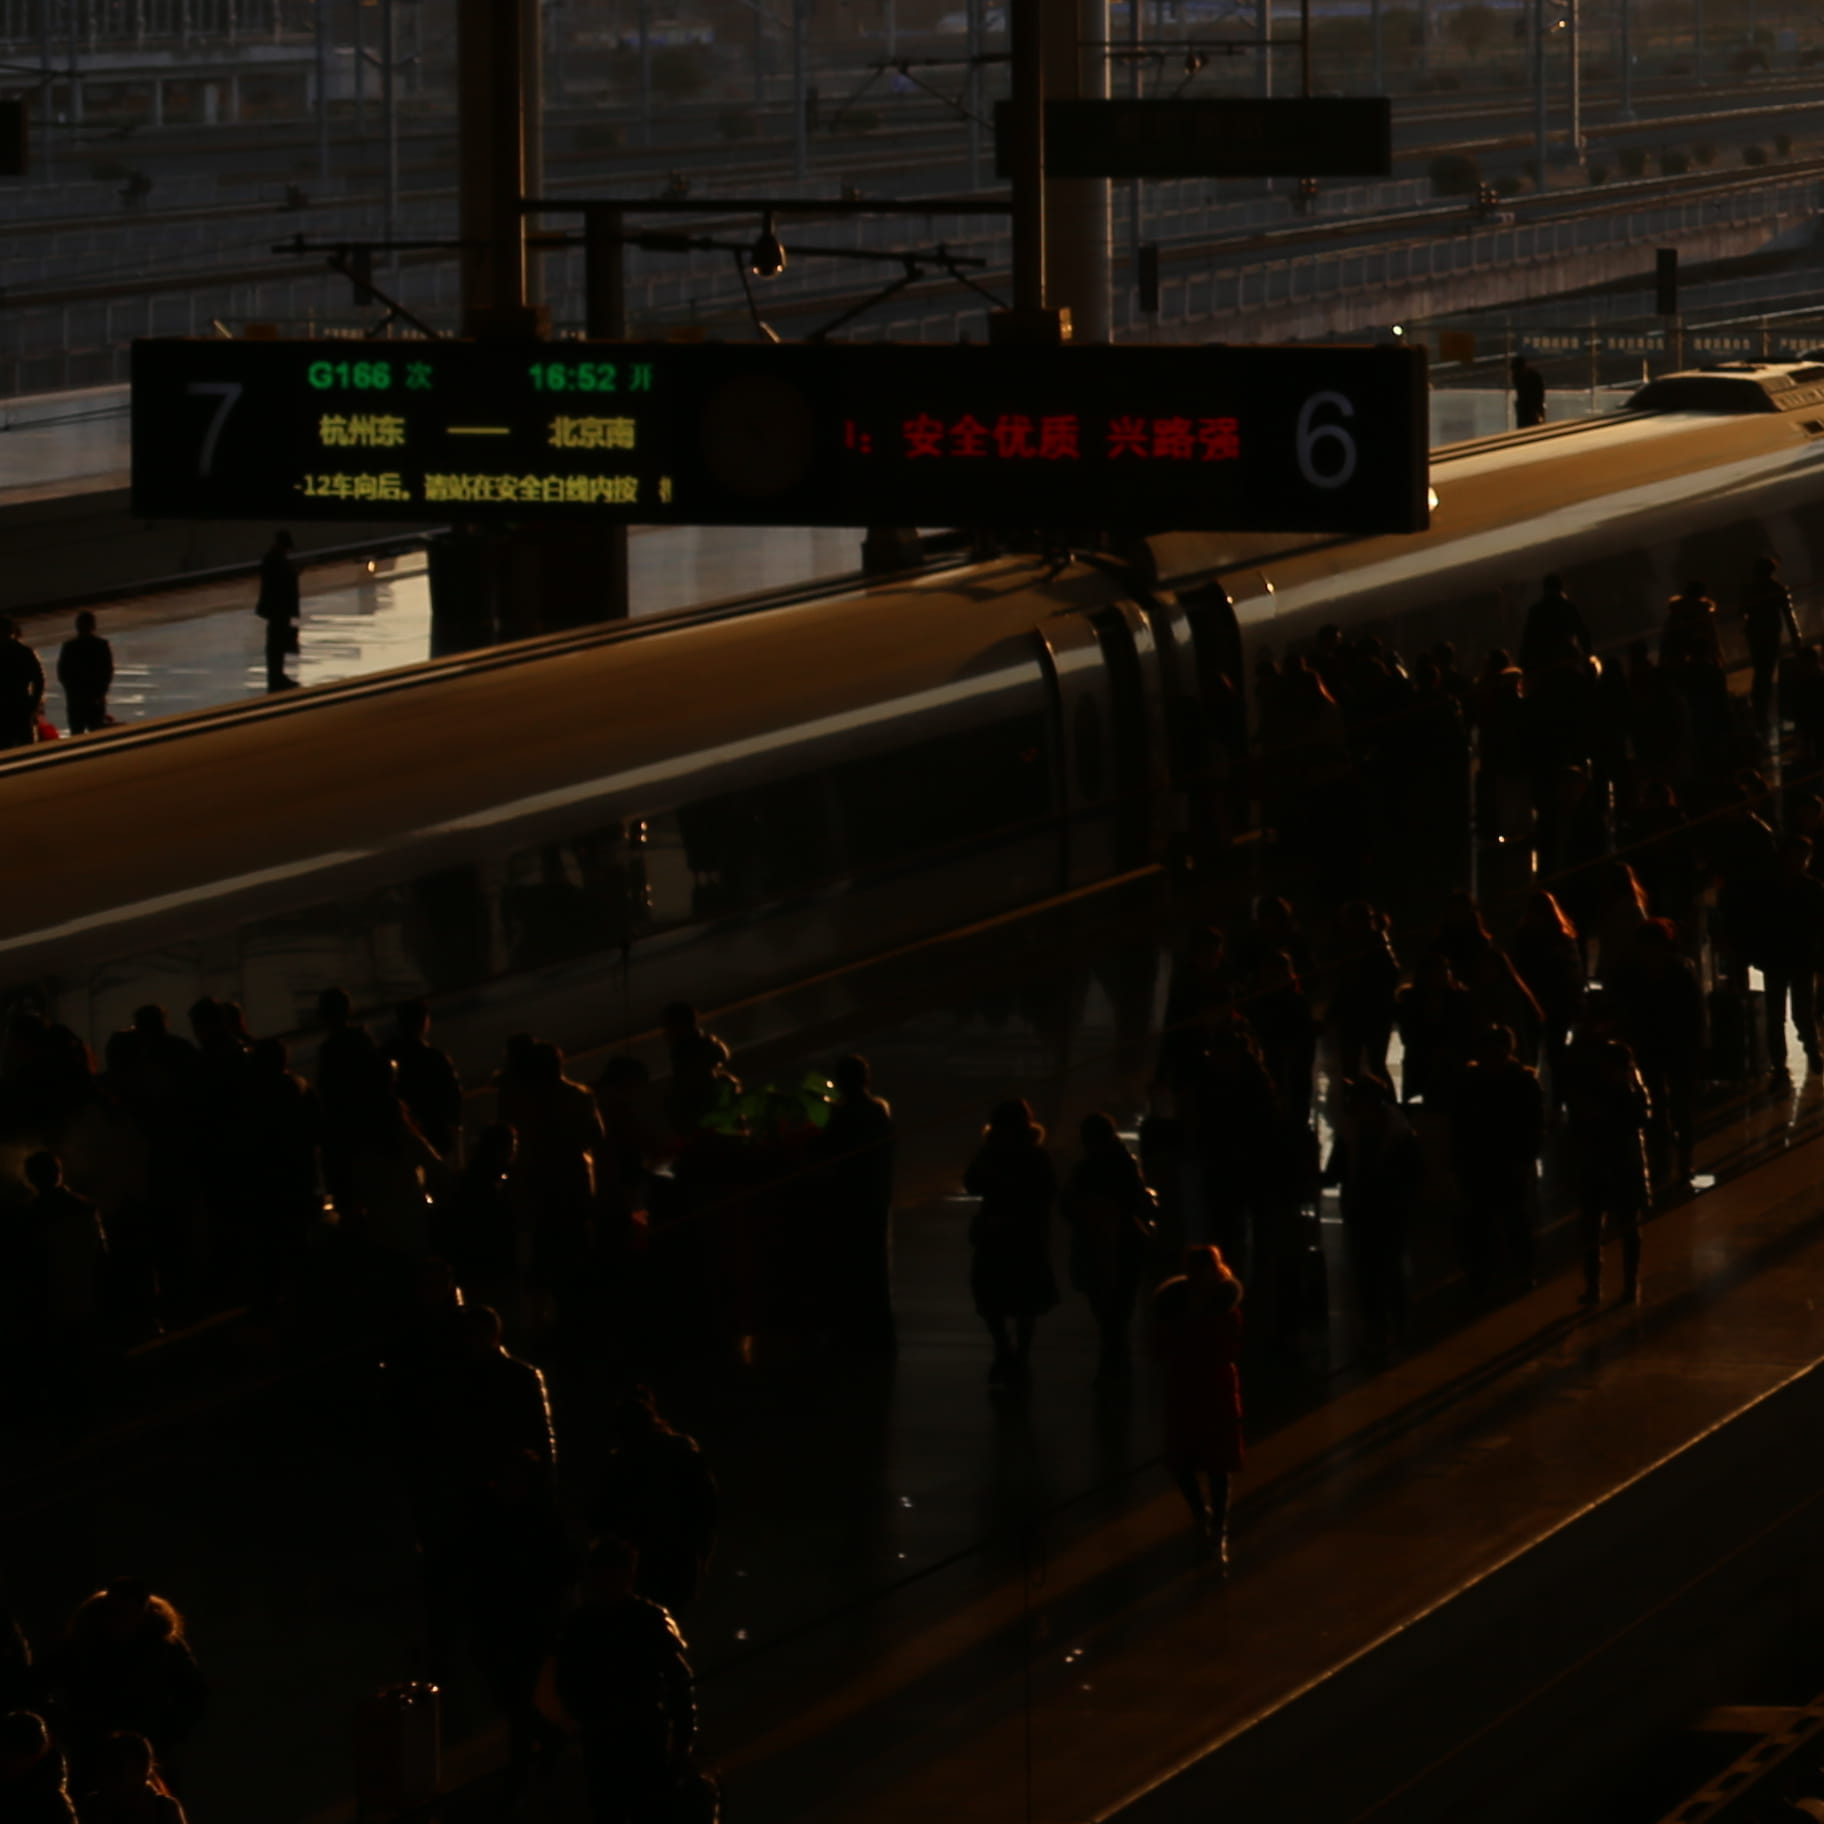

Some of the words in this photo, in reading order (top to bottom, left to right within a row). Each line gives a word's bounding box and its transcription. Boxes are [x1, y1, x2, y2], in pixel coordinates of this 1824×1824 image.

[308, 360, 392, 390] G166
[404, 360, 434, 391] 次
[528, 362, 617, 392] 16:52
[628, 363, 655, 393] 开
[185, 379, 246, 479] 7
[318, 413, 407, 448] 杭州东
[547, 415, 637, 450] 北京南
[901, 411, 1082, 461] 安全优质
[1295, 389, 1358, 490] 6
